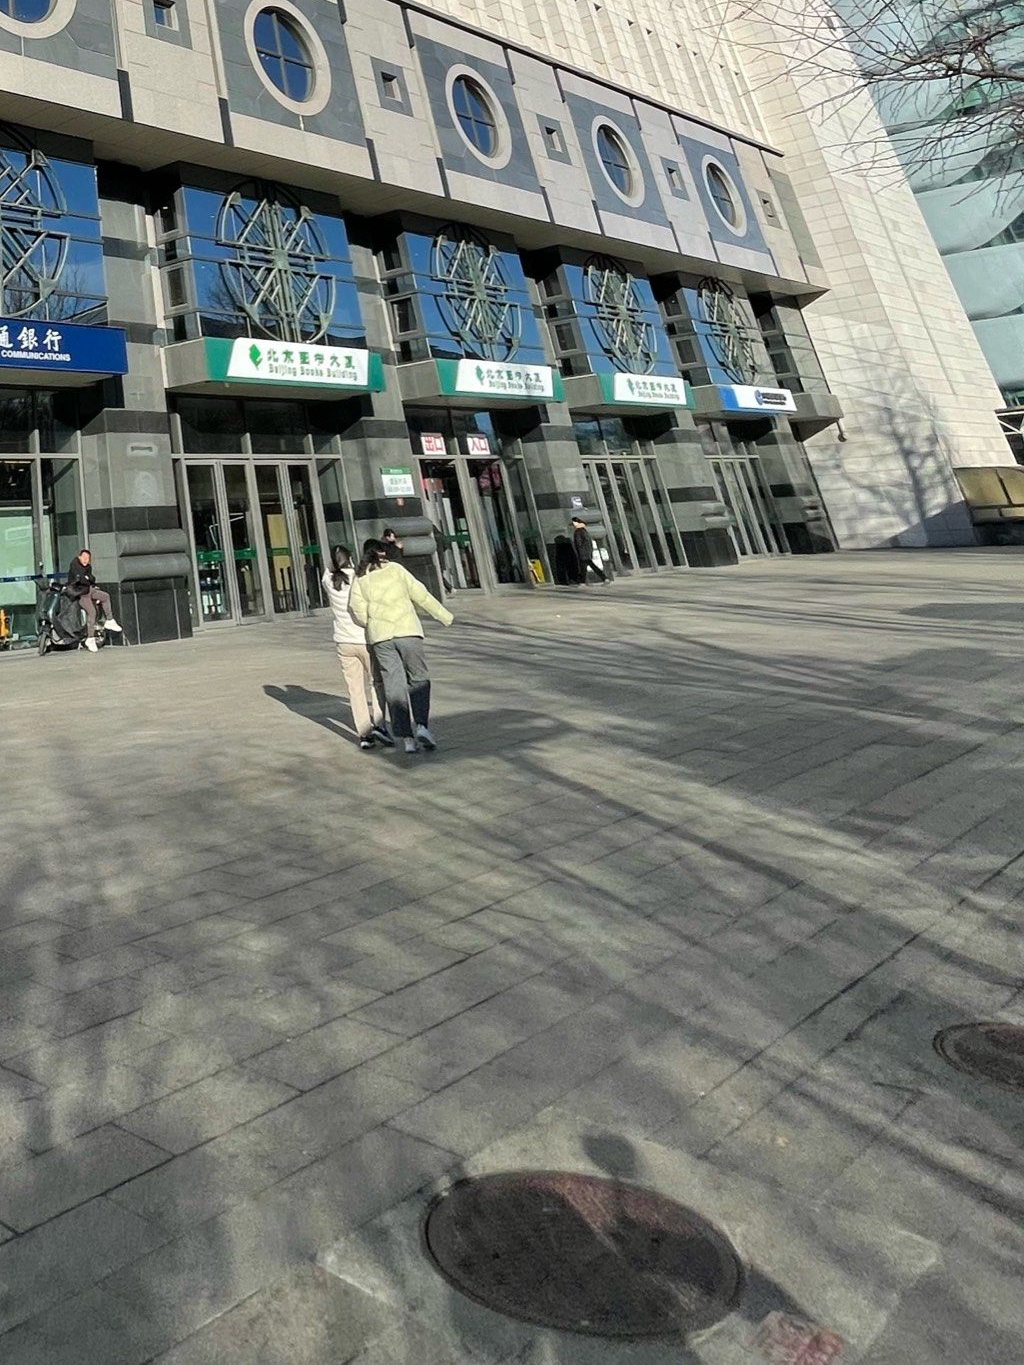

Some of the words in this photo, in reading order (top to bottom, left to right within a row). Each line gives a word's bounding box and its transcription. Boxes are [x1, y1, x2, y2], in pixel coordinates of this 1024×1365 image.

[1, 349, 72, 362] COMMUNICATIONS
[268, 363, 298, 377] Beijing
[300, 365, 324, 378] Books
[327, 367, 358, 382] Building
[425, 436, 444, 452] 出口
[471, 436, 488, 452] 入口
